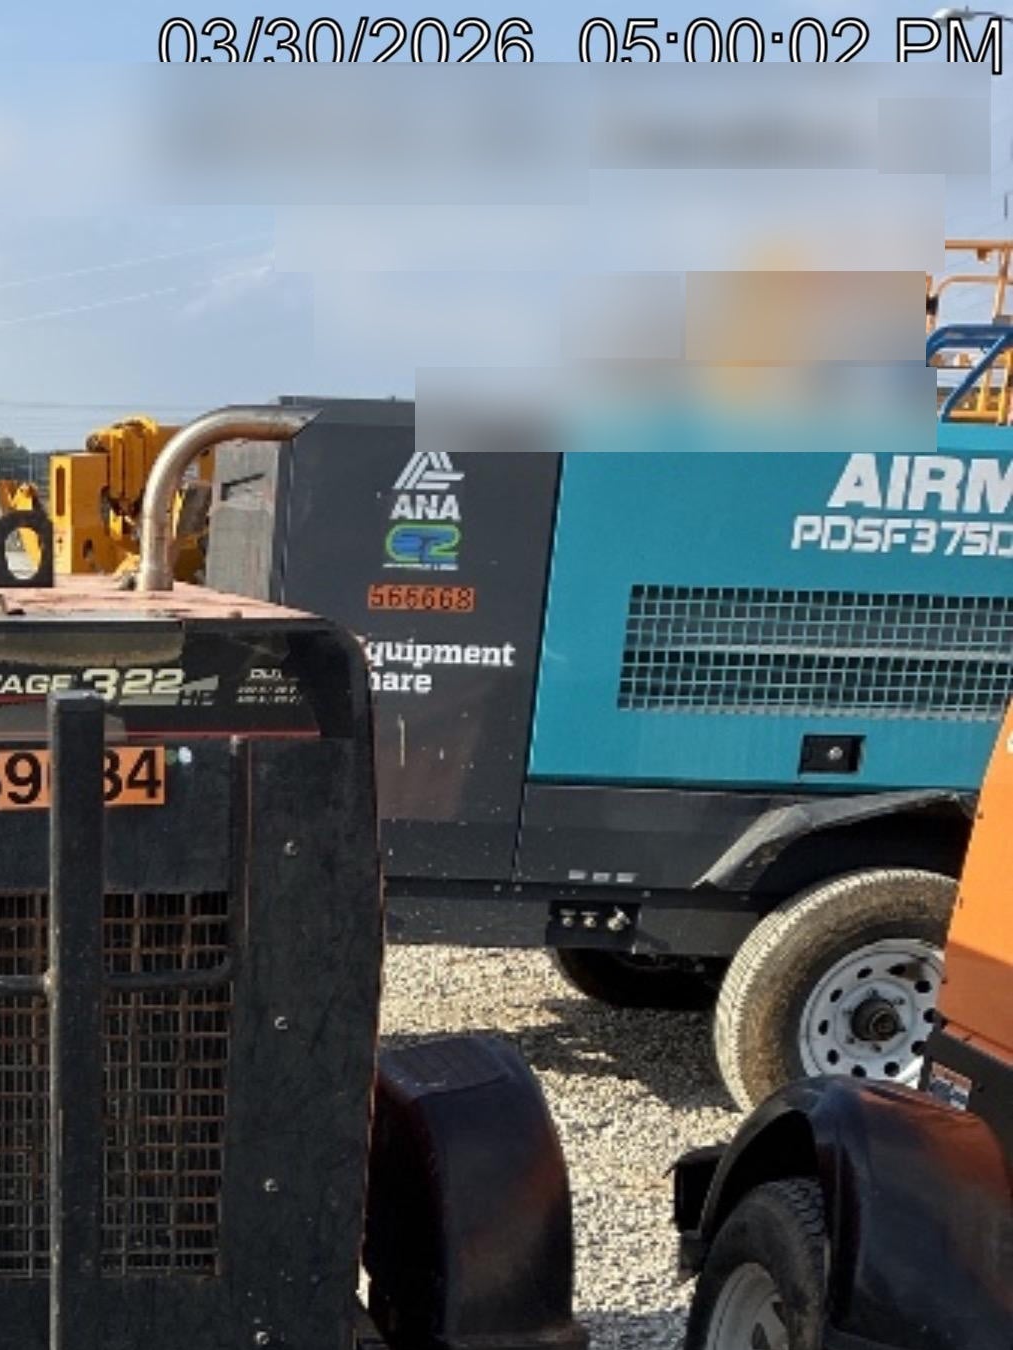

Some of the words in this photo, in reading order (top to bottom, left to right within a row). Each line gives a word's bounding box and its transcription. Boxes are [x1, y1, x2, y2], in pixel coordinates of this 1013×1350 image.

[390, 494, 461, 521] ANA
[358, 635, 517, 669] quipment
[81, 668, 184, 701] 322
[369, 669, 433, 694] hare
